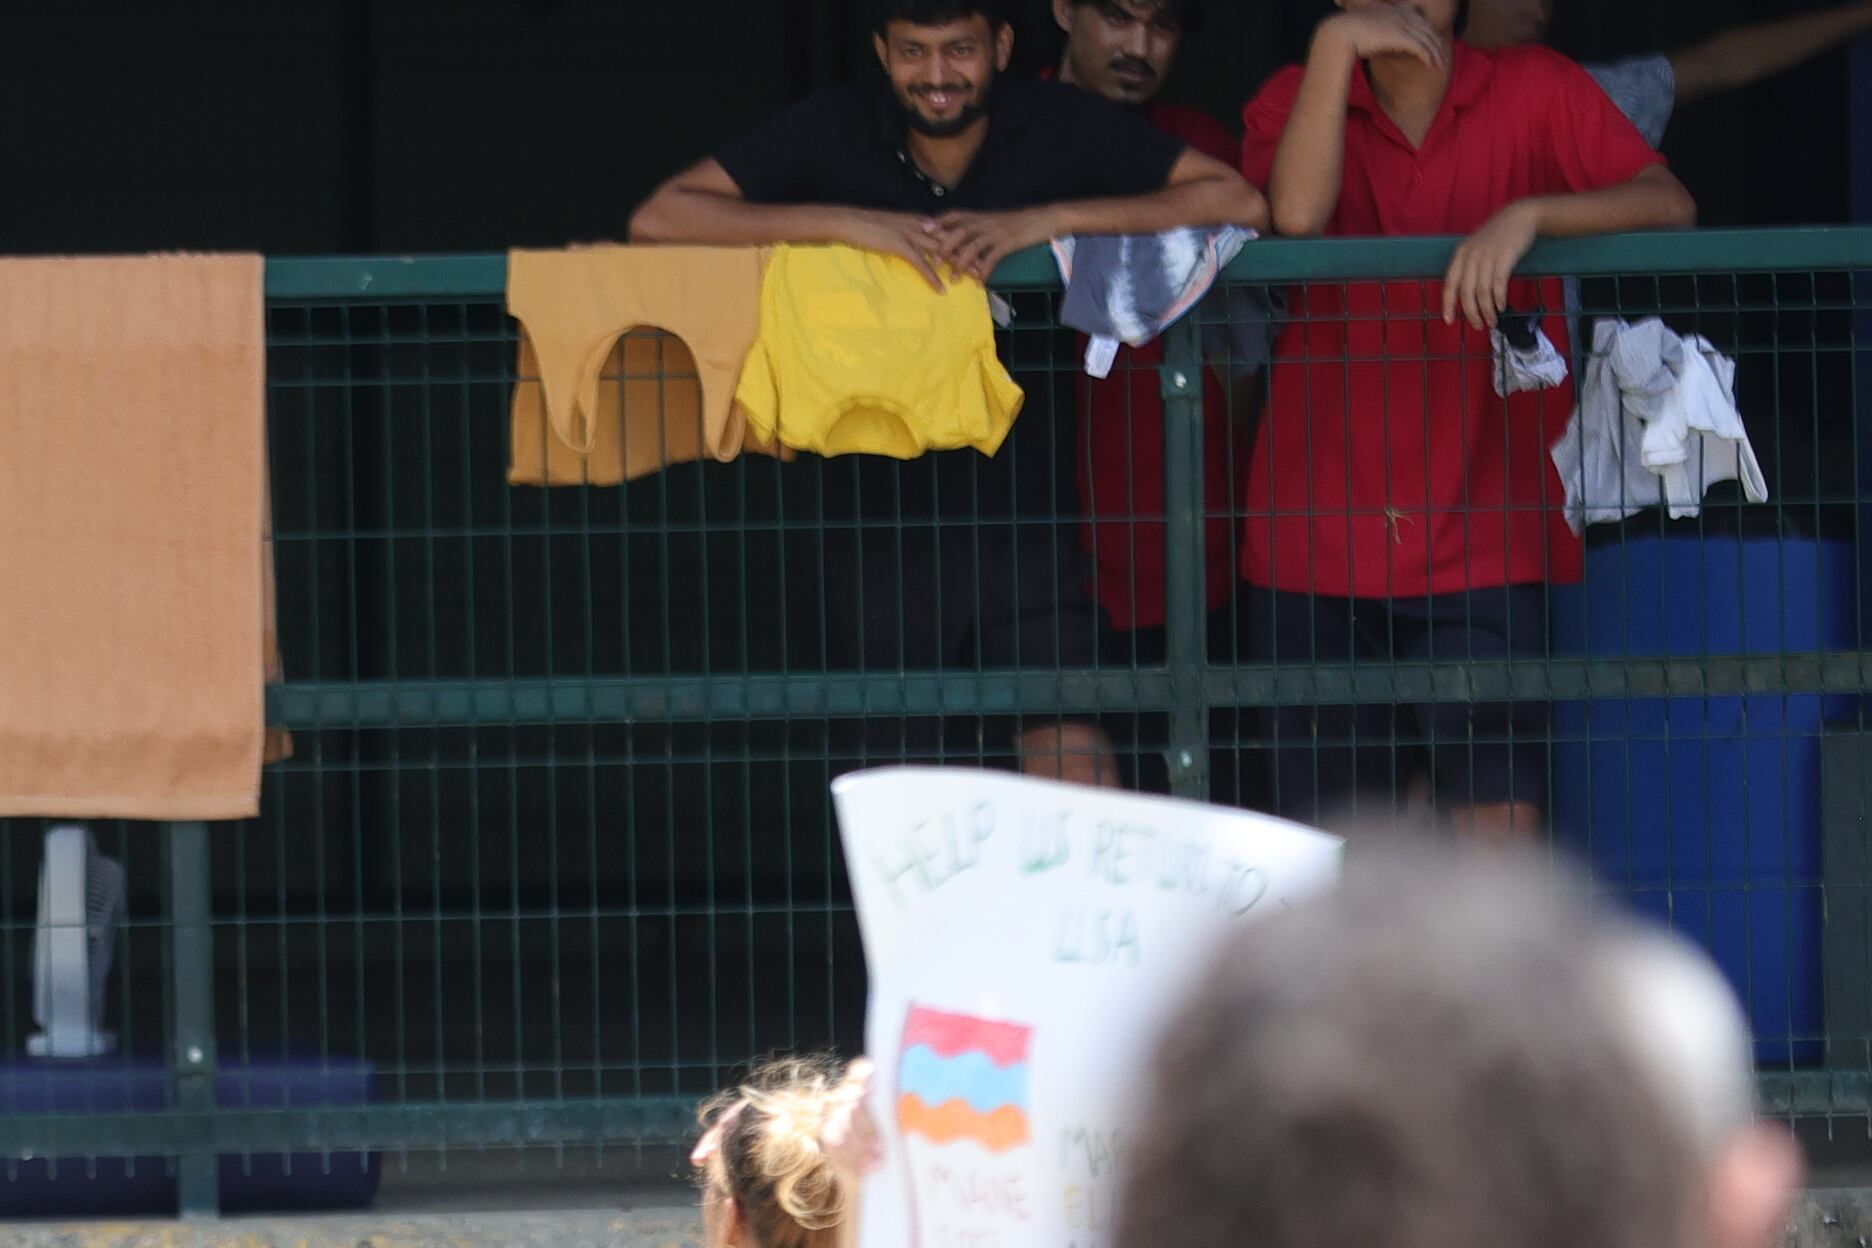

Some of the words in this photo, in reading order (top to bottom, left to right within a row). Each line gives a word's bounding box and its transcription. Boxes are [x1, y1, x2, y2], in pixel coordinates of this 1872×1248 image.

[872, 801, 997, 912] HELP
[1017, 809, 1073, 877] US
[1053, 906, 1142, 969] USA
